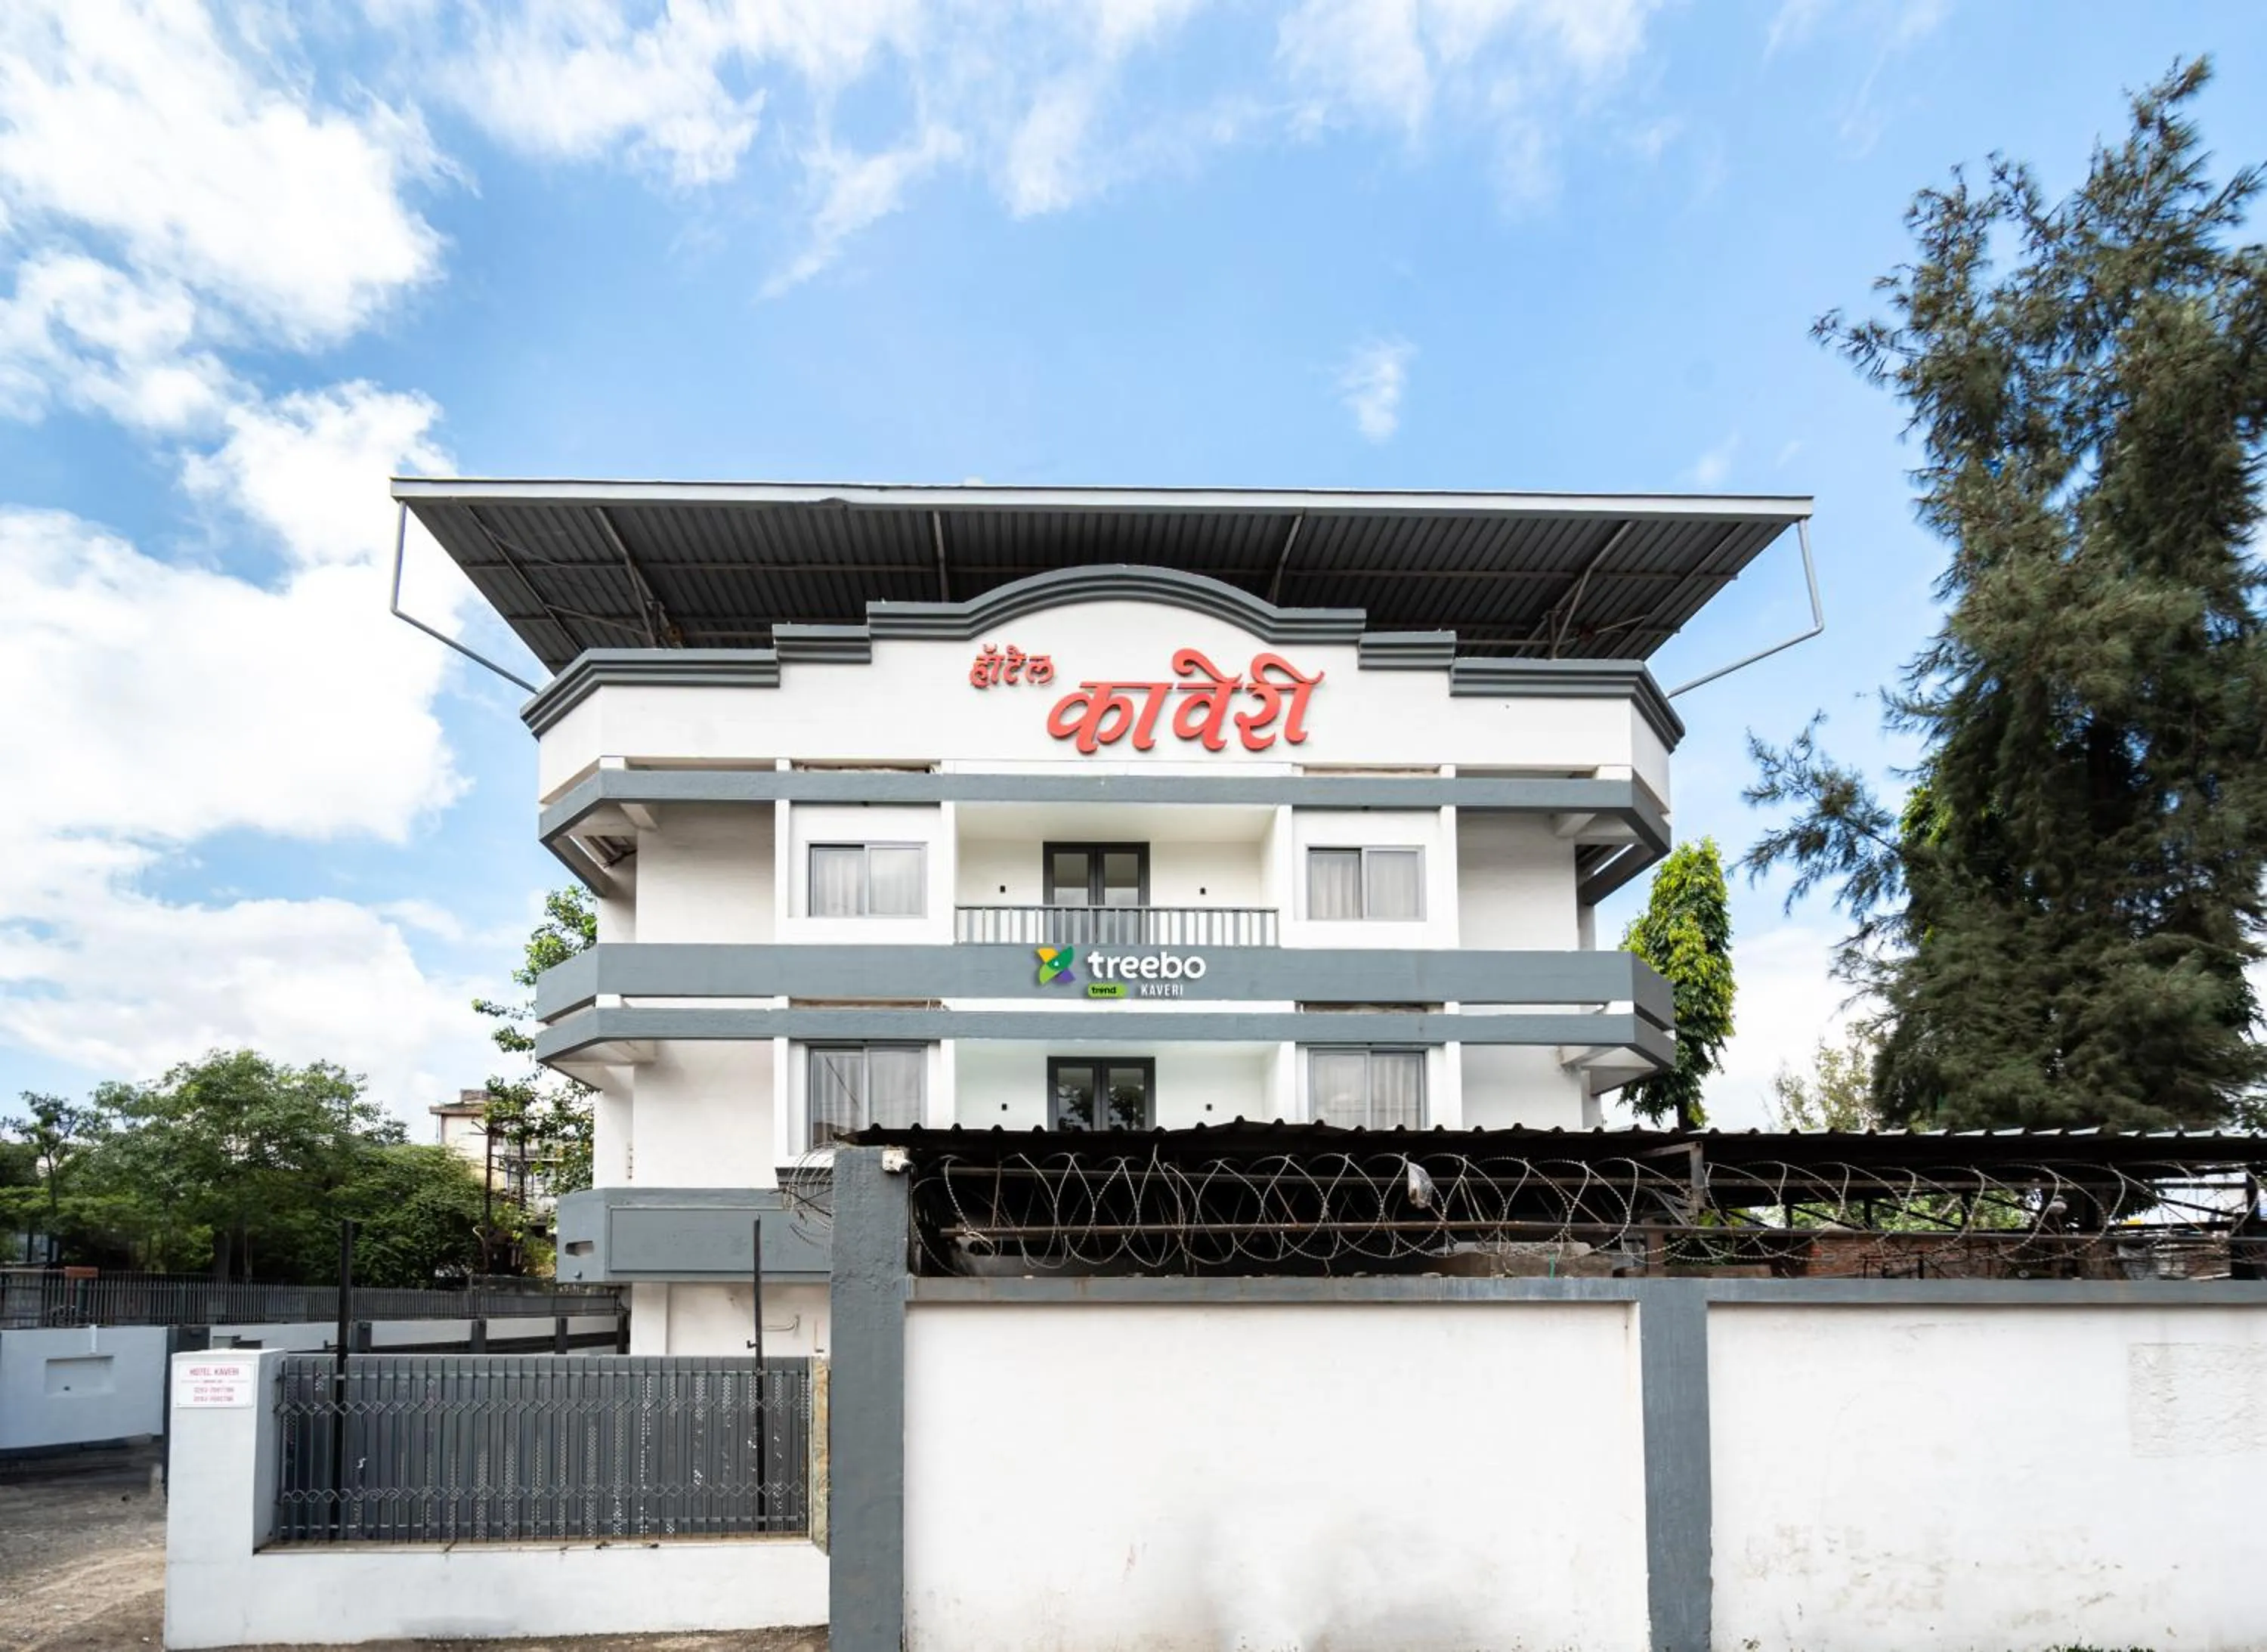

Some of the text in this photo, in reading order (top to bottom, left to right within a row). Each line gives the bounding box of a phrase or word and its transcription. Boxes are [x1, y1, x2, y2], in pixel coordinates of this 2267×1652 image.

[969, 645, 1054, 688] हॉटेल
[1047, 648, 1325, 753] कावेरी
[1087, 951, 1206, 979] treebo
[1091, 985, 1117, 995] trend
[1140, 985, 1183, 996] KAVERI
